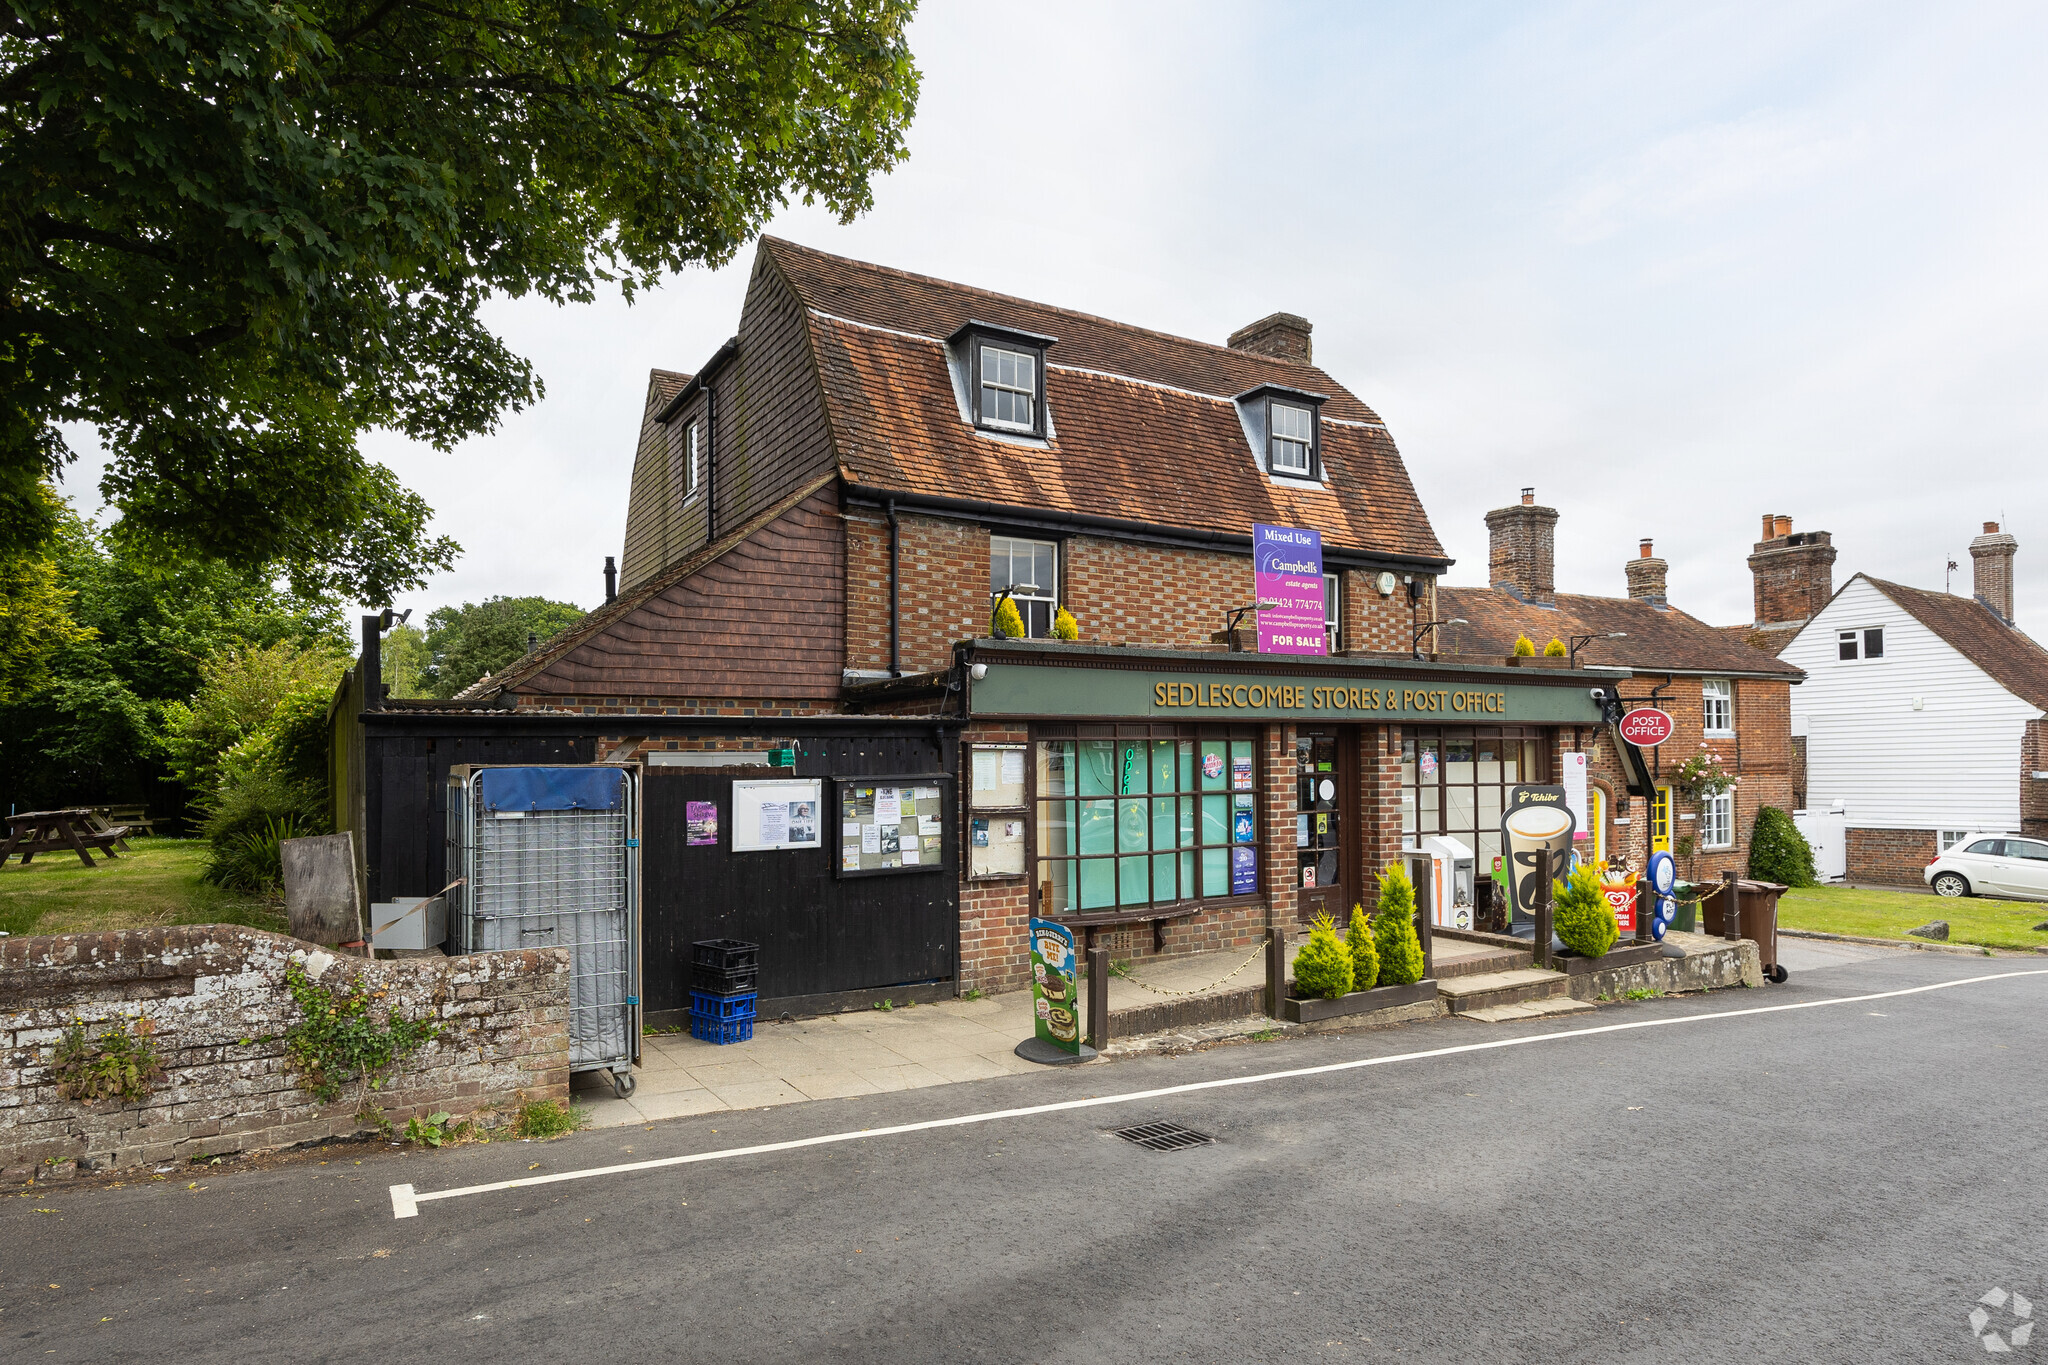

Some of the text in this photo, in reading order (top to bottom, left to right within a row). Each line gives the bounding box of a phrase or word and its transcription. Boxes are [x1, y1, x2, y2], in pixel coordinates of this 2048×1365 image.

[1264, 529, 1312, 545] Mixed Use
[1271, 558, 1318, 574] Campbell's
[1285, 580, 1318, 590] estate agents
[1295, 598, 1323, 611] 774774
[1272, 635, 1322, 648] FOR SALE
[1154, 682, 1505, 713] SEDLESCOMBE STORES & POST OFFICE
[1632, 716, 1662, 726] POST
[1625, 726, 1665, 736] OFFICE
[1530, 793, 1560, 802] Tchibo
[1044, 940, 1060, 953] BITE
[1046, 951, 1059, 963] ME!
